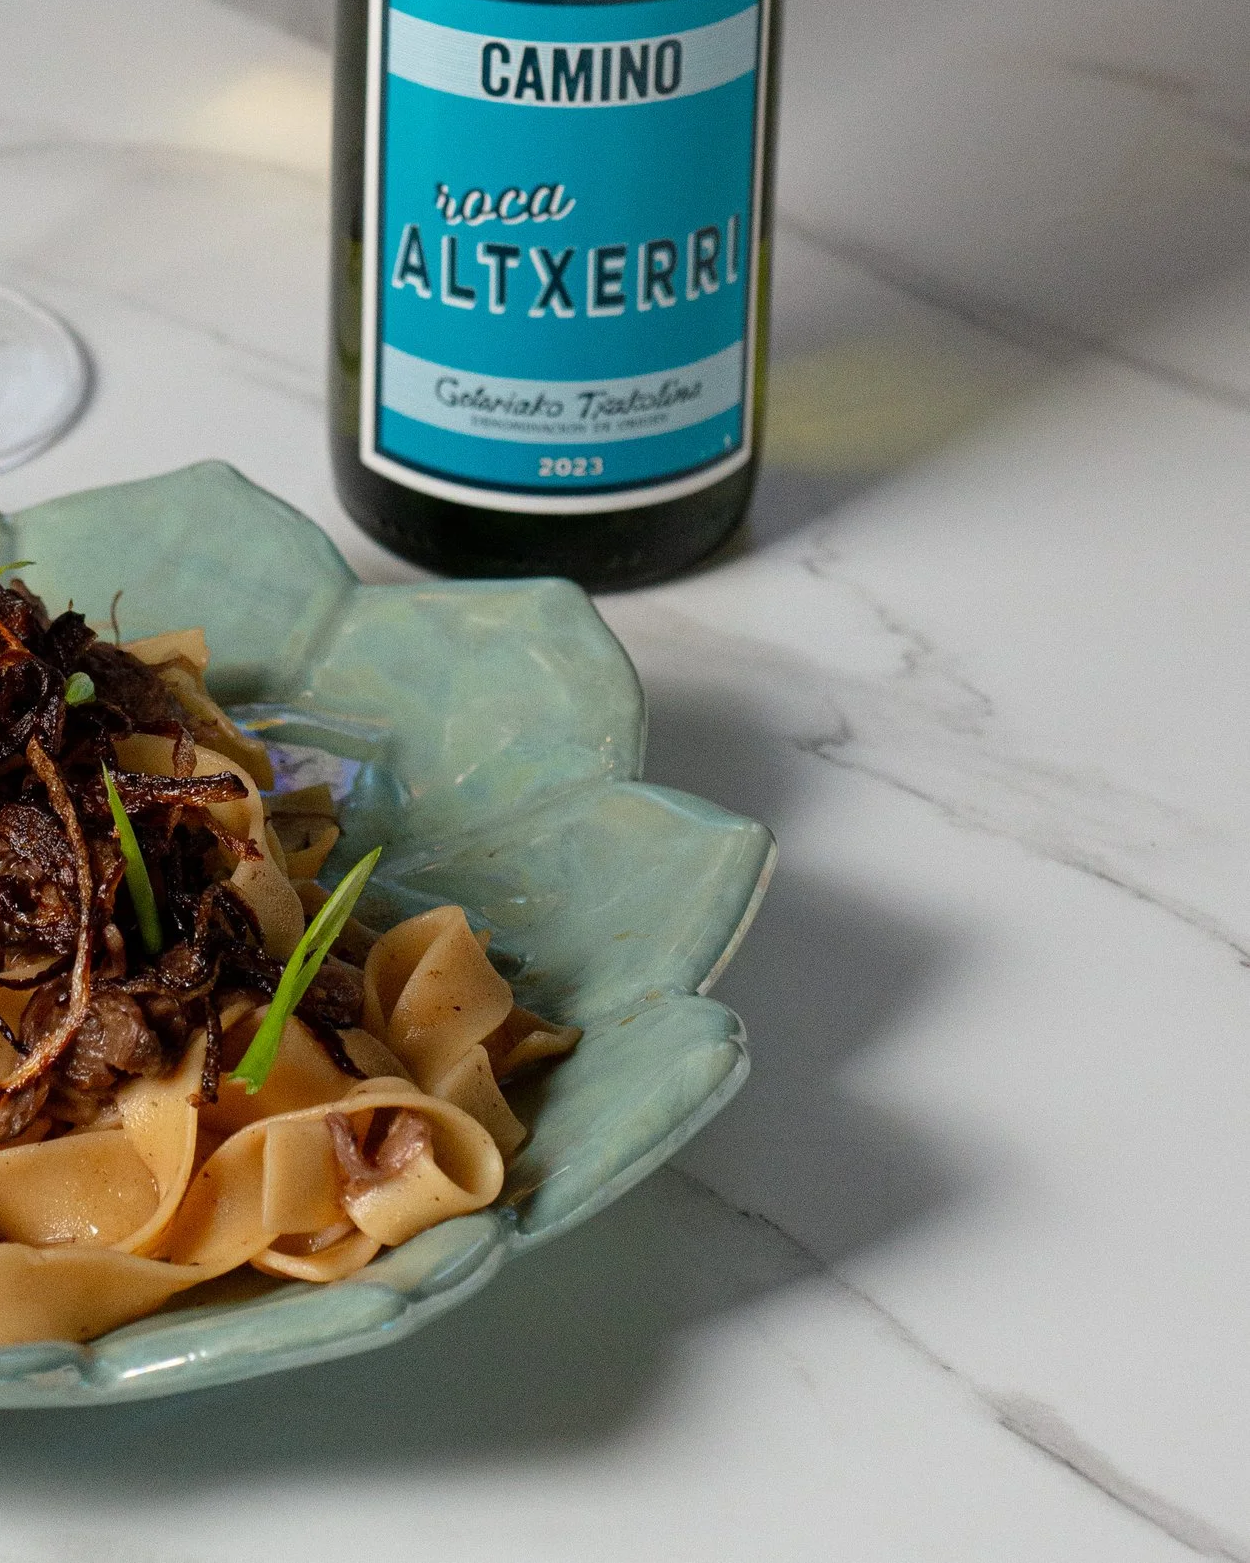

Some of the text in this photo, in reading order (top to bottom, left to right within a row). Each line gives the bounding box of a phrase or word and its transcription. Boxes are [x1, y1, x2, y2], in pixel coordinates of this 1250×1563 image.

[481, 38, 683, 103] CAMINO
[435, 181, 576, 226] roca
[391, 211, 740, 319] ALTXERRI
[538, 456, 604, 478] 2023
